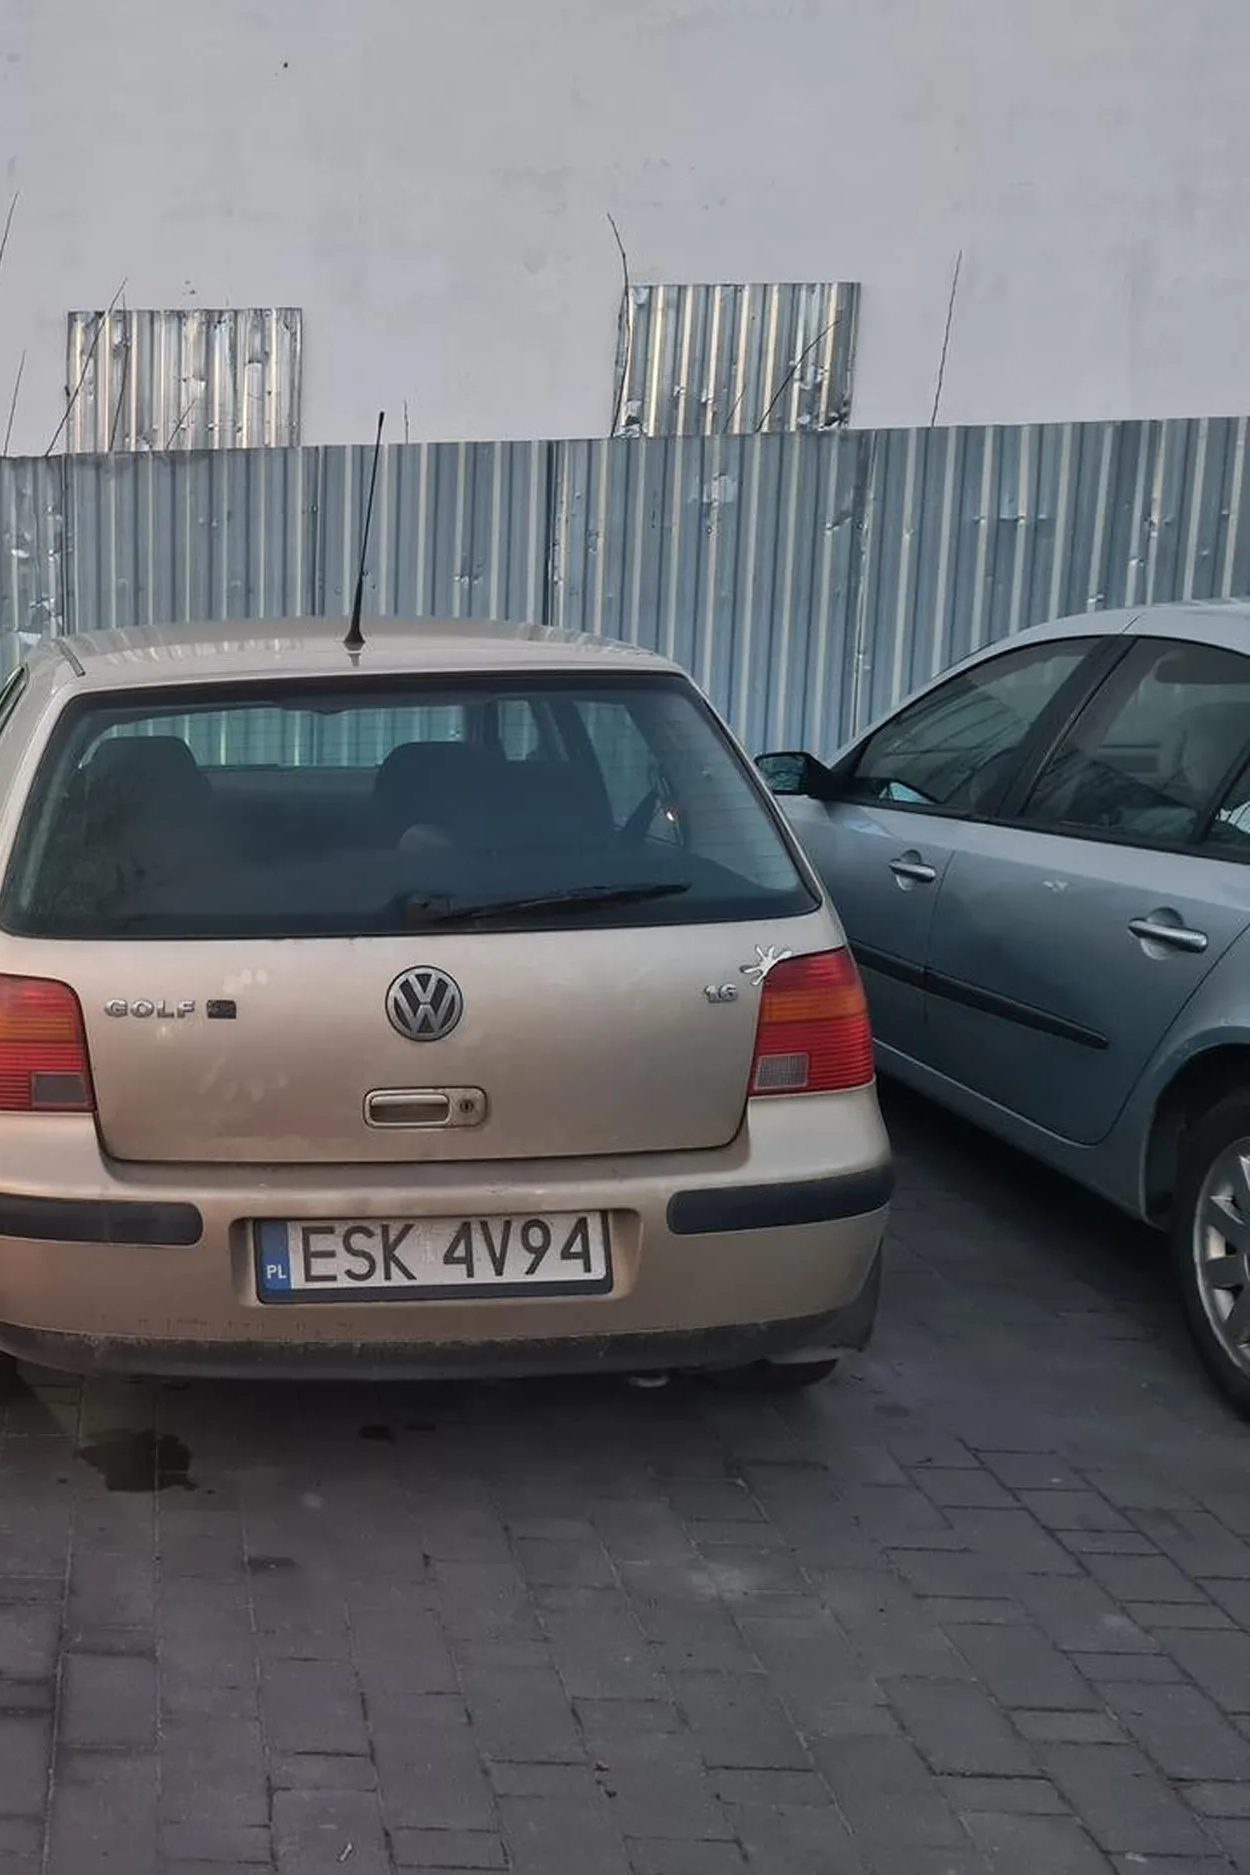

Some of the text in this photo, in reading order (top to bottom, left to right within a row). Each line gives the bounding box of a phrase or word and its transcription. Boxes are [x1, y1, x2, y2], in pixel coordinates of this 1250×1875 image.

[104, 998, 195, 1018] GOLF
[300, 1217, 592, 1282] ESK 4V94
[266, 1265, 287, 1279] PL
